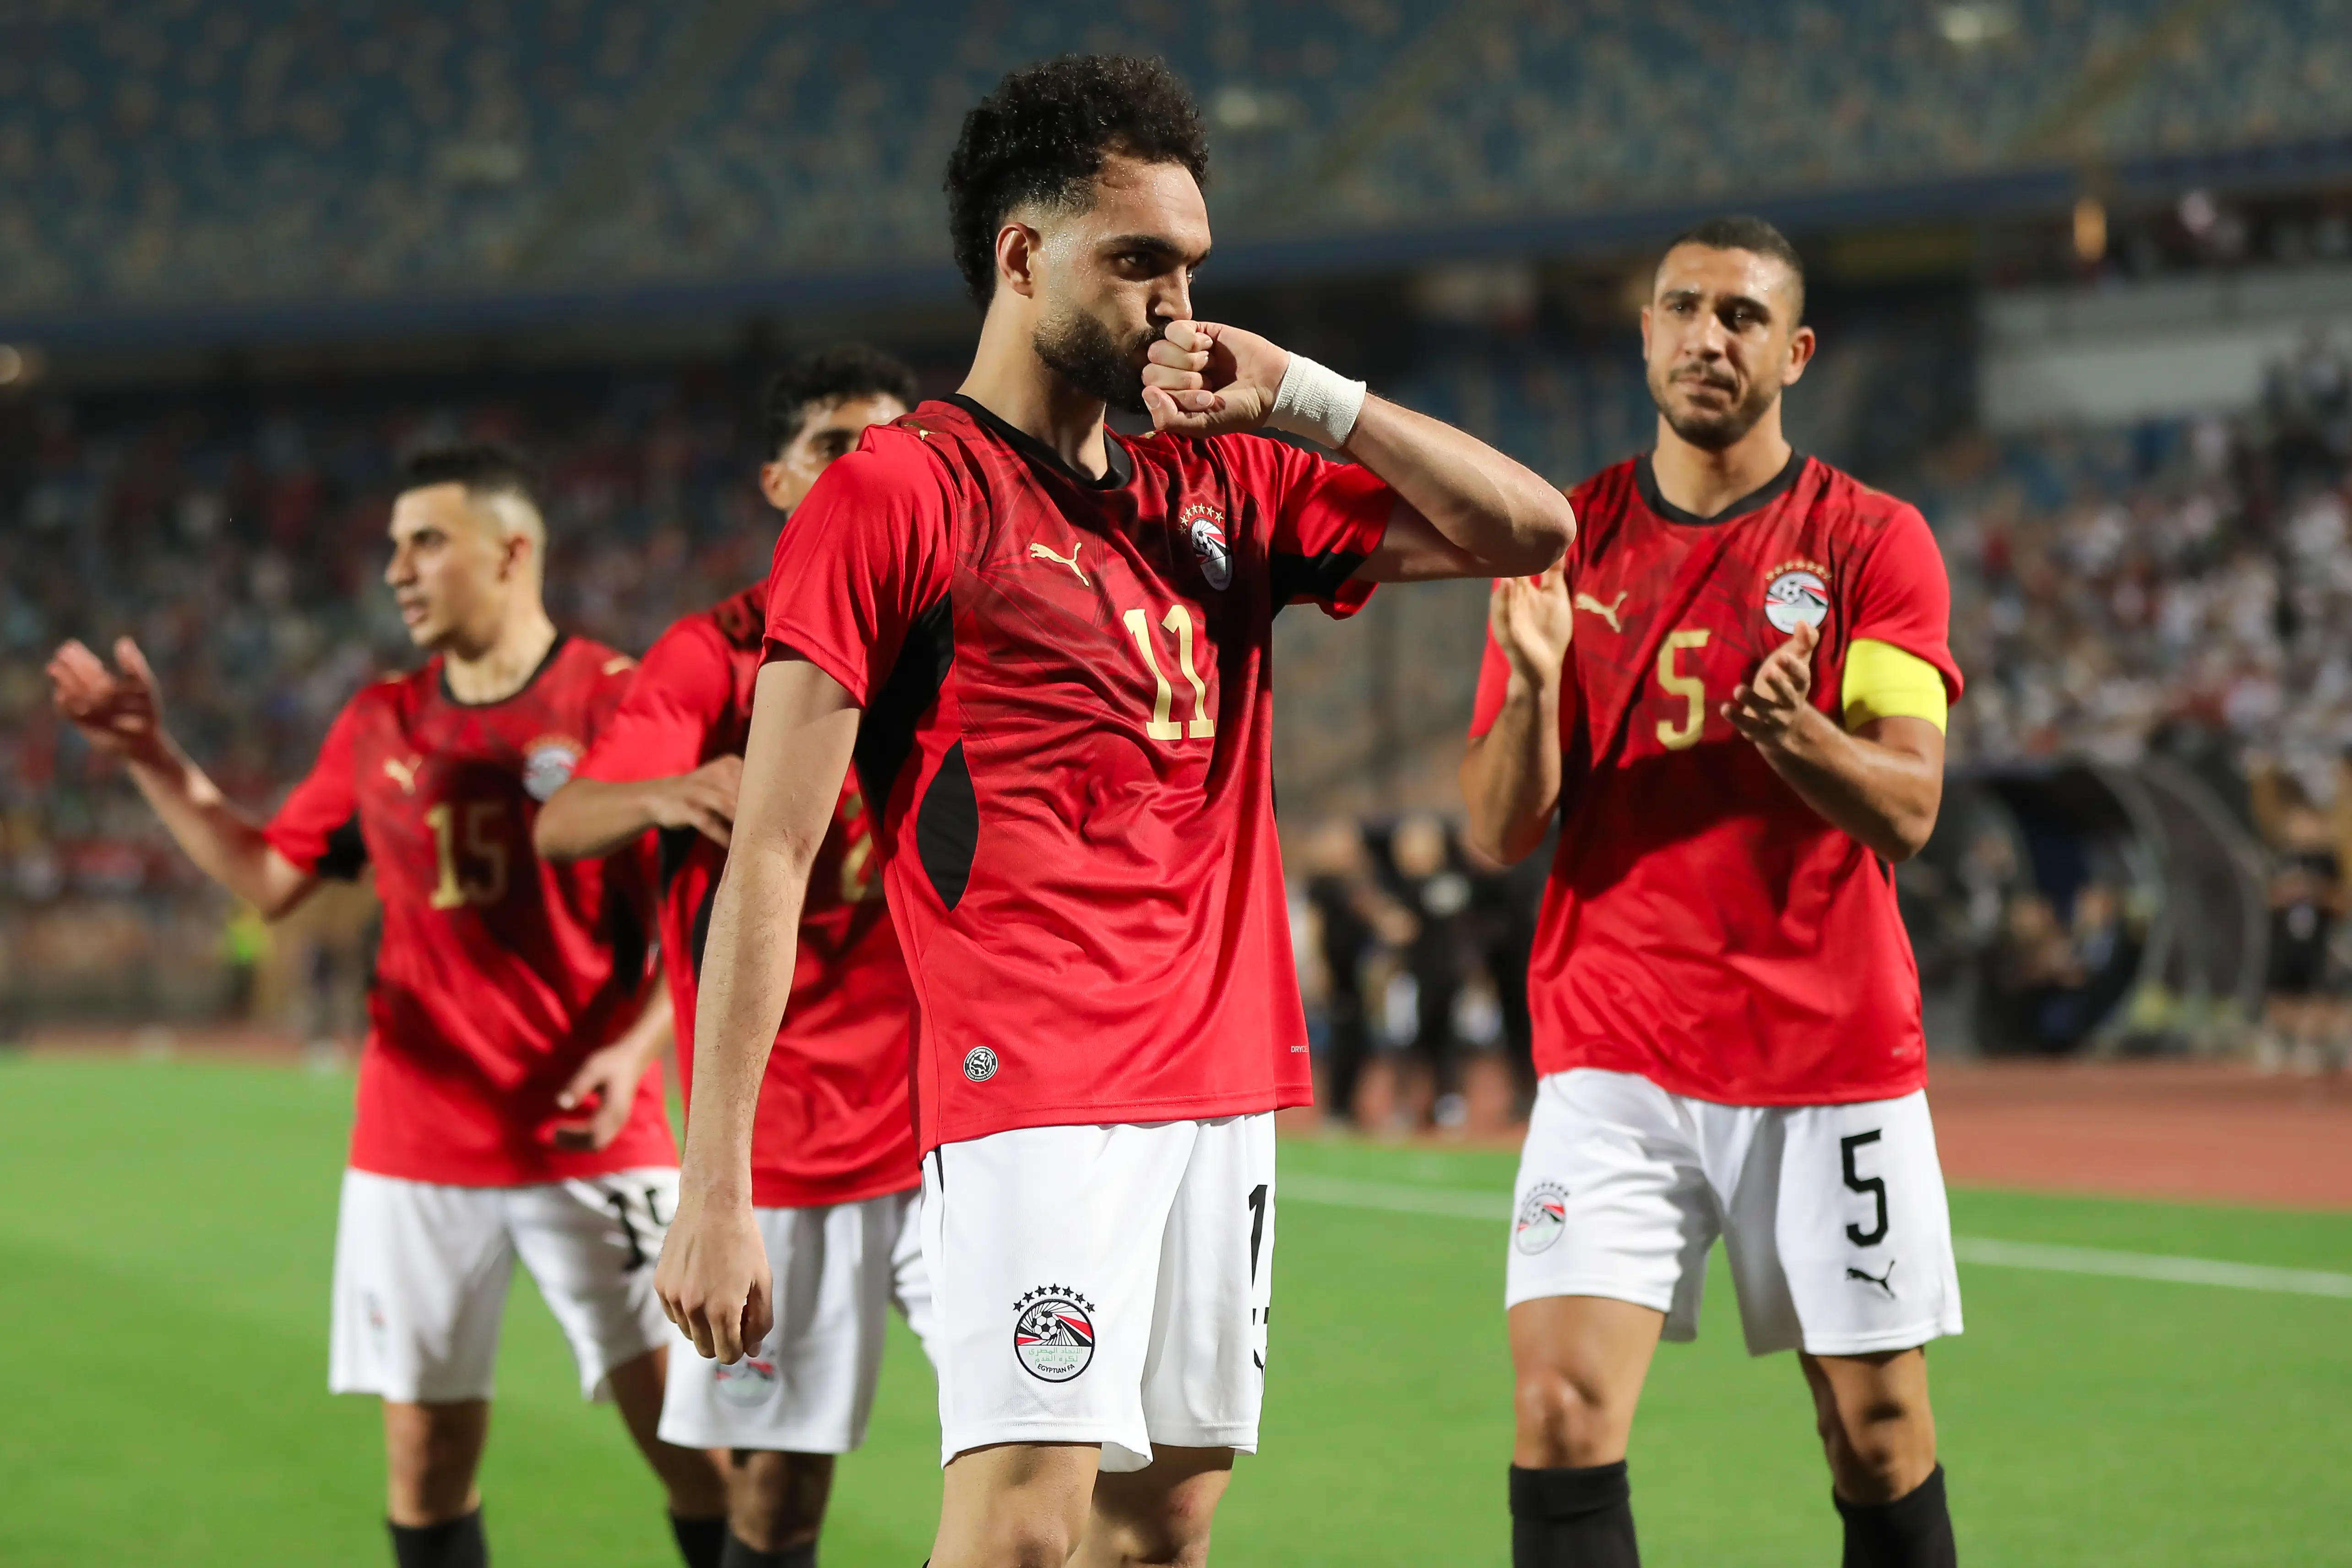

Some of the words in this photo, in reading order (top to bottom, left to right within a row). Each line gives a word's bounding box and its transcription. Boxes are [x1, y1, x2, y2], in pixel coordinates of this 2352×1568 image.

[1123, 604, 1215, 740] 11
[1656, 629, 1711, 750] 5
[426, 802, 508, 910] 15
[1841, 1129, 1888, 1248] 5
[1037, 1364, 1066, 1373] EGYPTIAN
